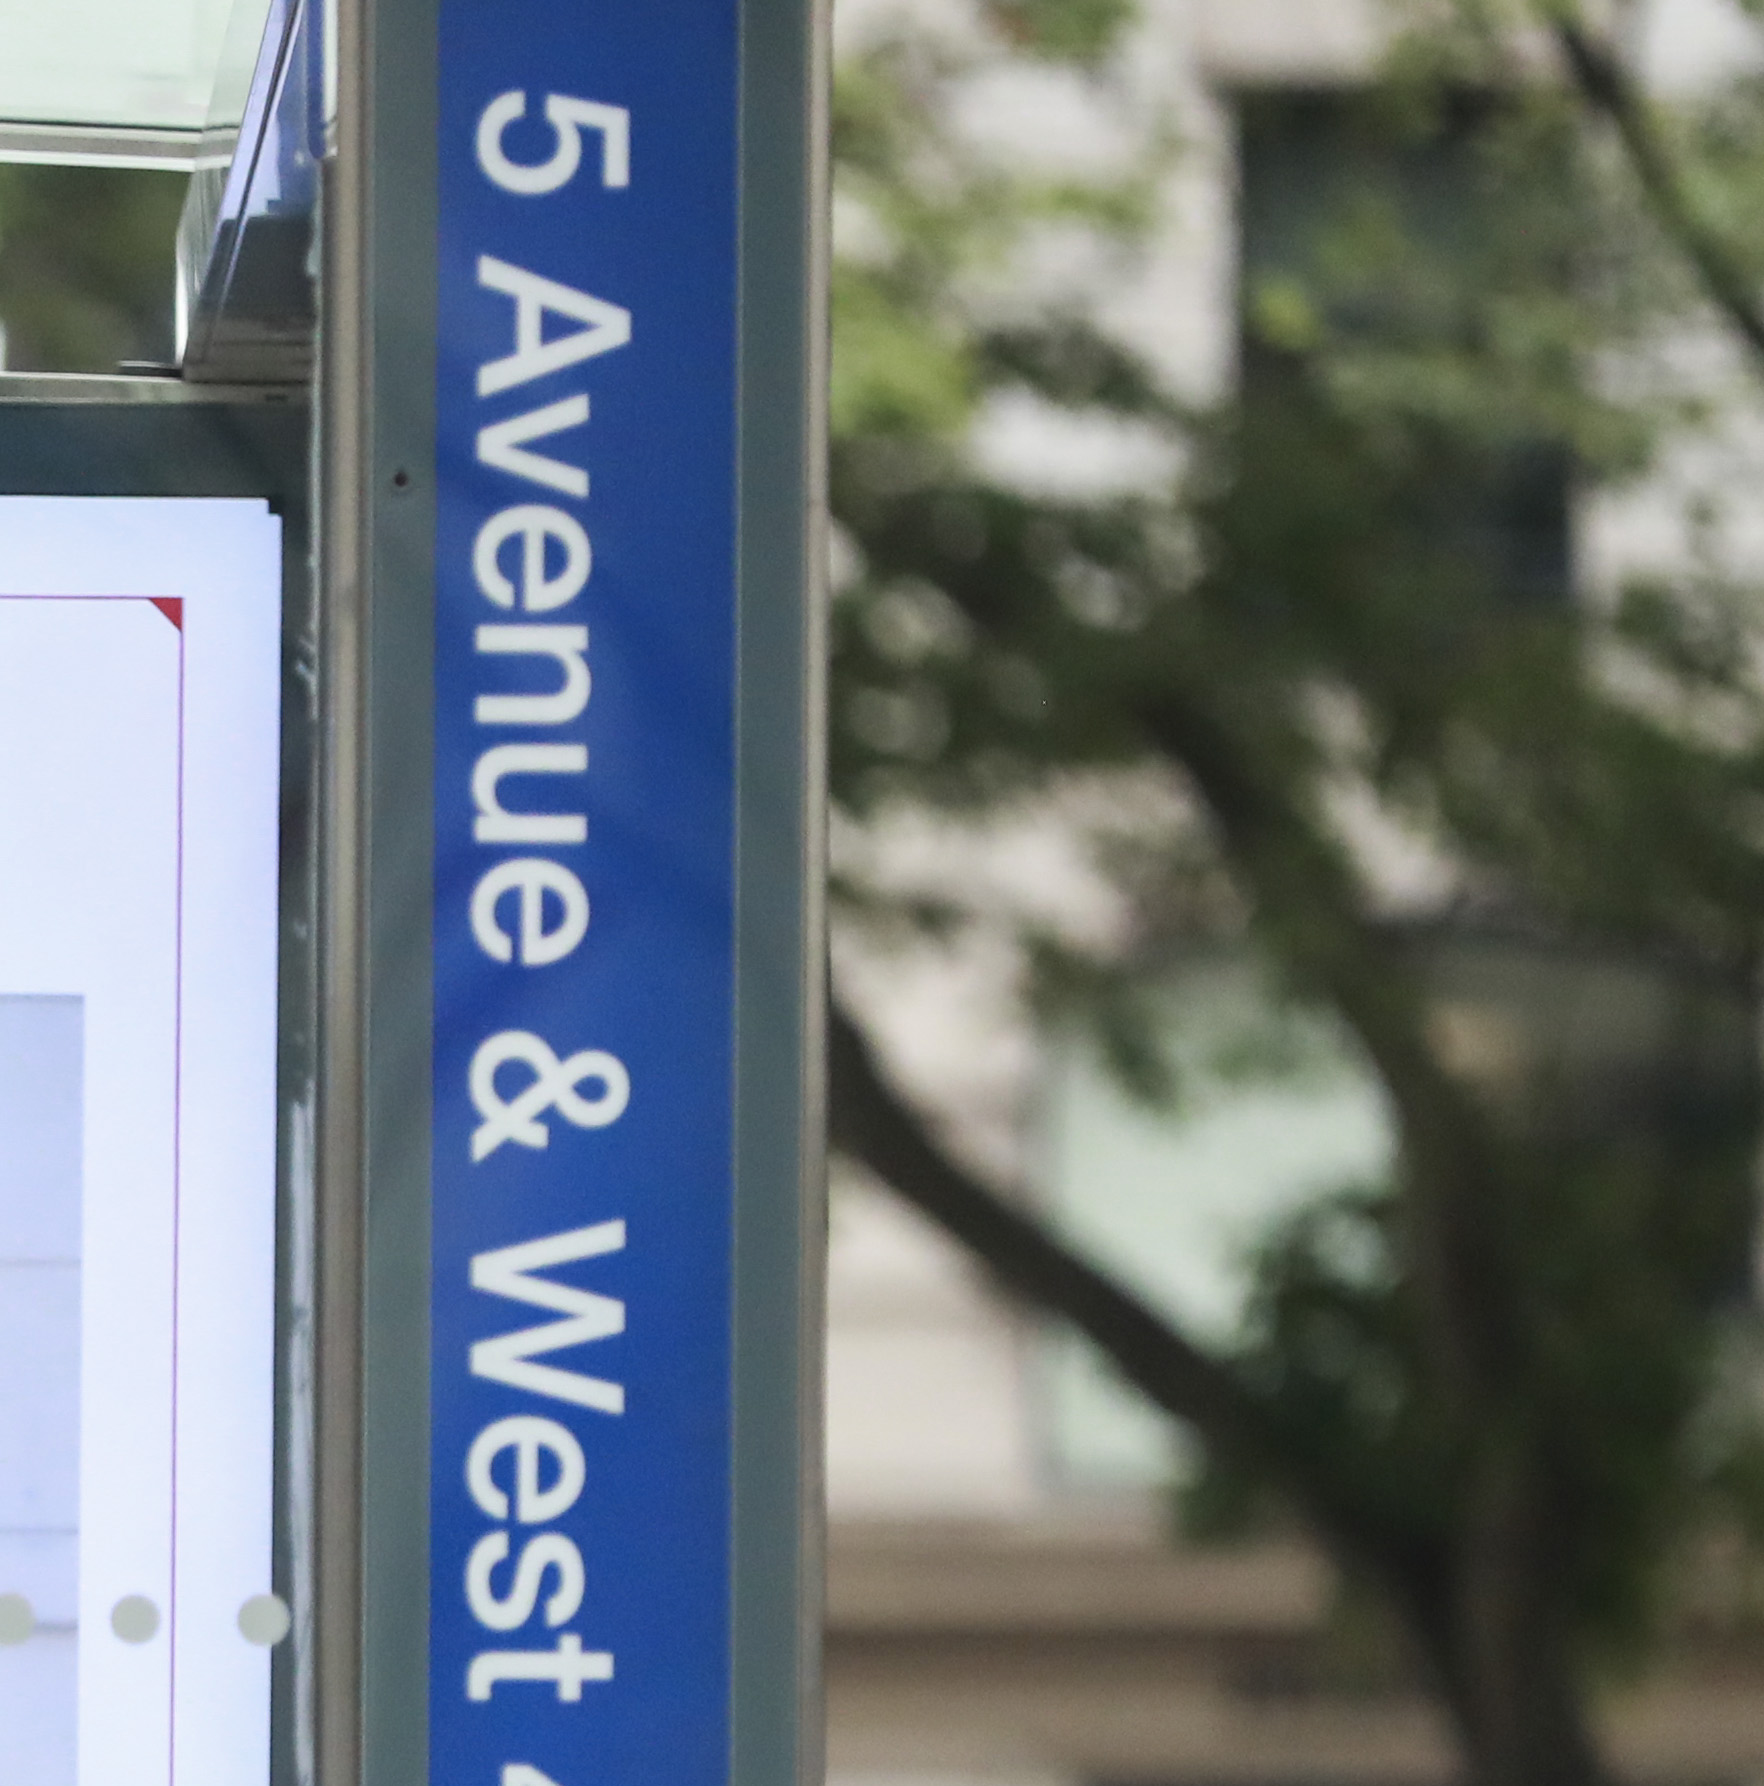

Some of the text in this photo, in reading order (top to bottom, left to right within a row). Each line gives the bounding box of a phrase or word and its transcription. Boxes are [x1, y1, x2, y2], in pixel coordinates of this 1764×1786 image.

[475, 88, 631, 196] 5
[470, 254, 633, 968] Avenue
[467, 1029, 631, 1163] &
[463, 1218, 626, 1703] West
